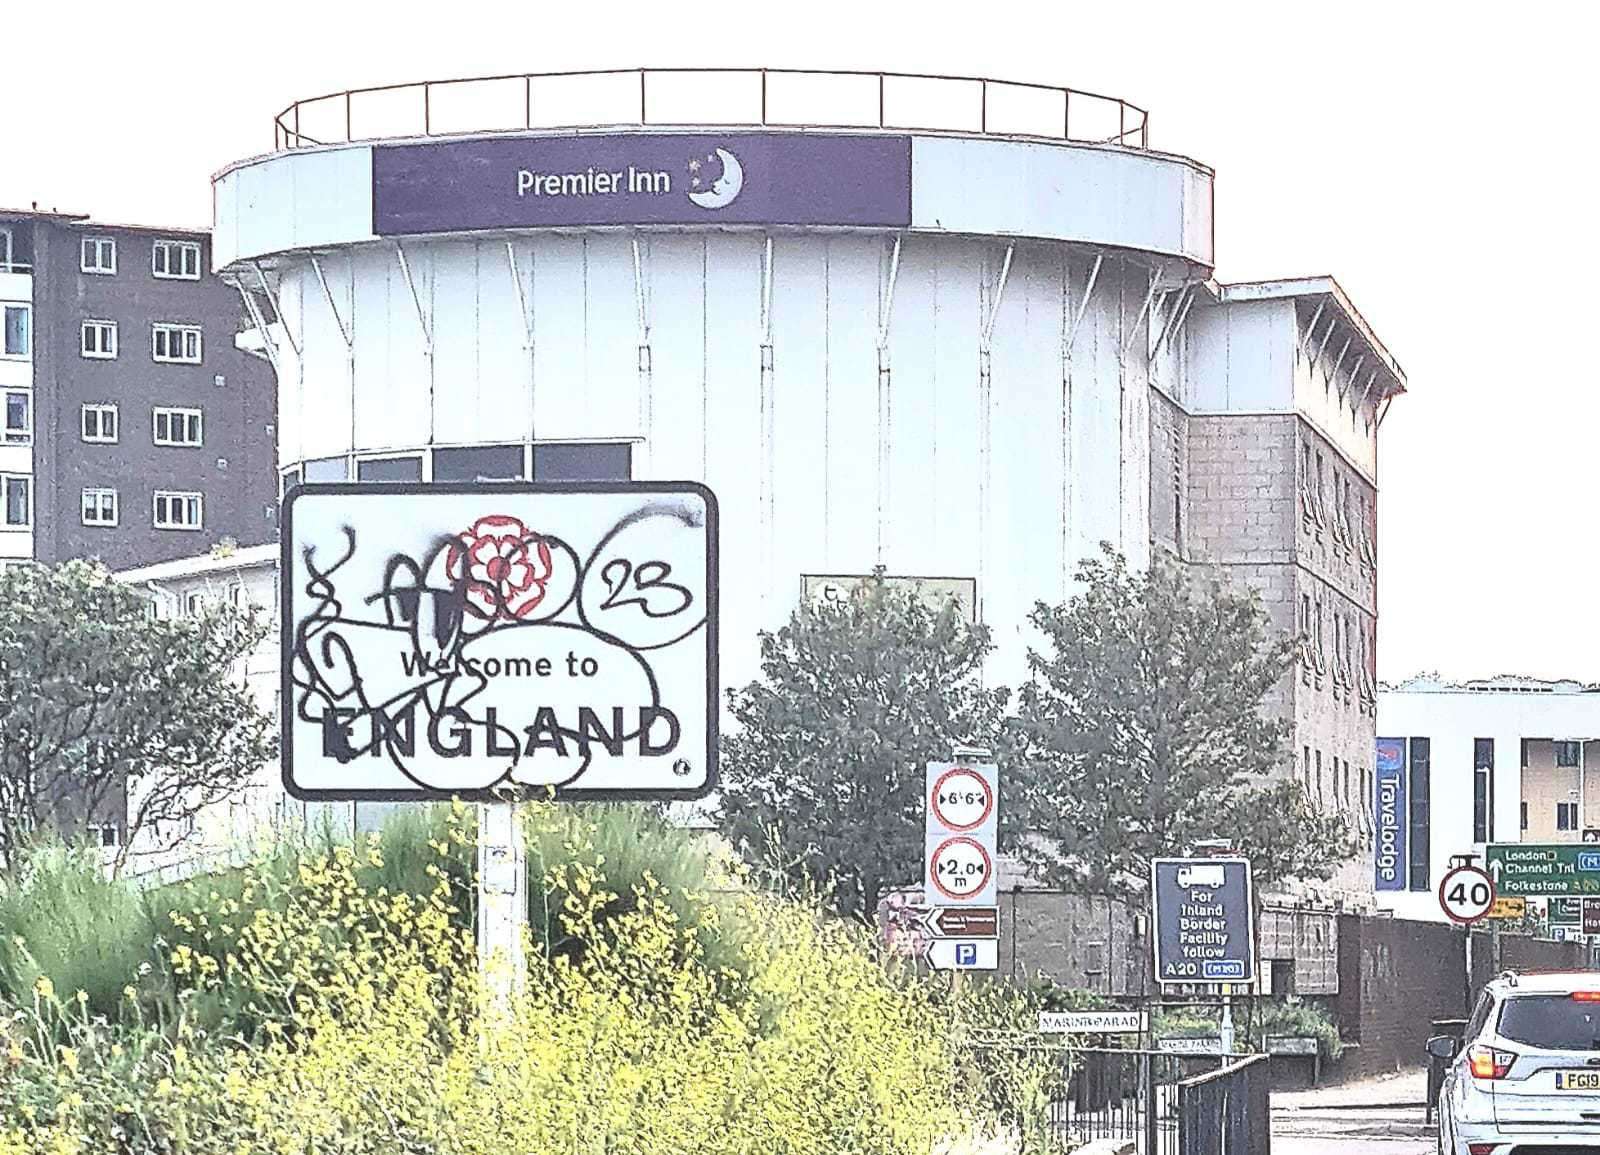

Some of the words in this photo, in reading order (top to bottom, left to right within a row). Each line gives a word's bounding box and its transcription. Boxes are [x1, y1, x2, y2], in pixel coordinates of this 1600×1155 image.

[517, 168, 623, 196] Premier
[628, 166, 671, 193] Inn
[564, 651, 599, 677] to
[322, 705, 681, 759] ENGLAND
[1376, 773, 1400, 881] Travelodge
[1505, 851, 1547, 861] London
[947, 859, 976, 876] 2.0
[1505, 863, 1553, 874] Channel
[954, 877, 967, 887] m
[1505, 880, 1568, 891] Folkestone
[1191, 890, 1214, 902] For
[1447, 881, 1490, 907] 40
[1181, 903, 1223, 916] Inland
[1180, 918, 1227, 930] Border
[1180, 932, 1228, 946] Facility
[1183, 946, 1225, 957] follow
[1166, 962, 1197, 975] A20
